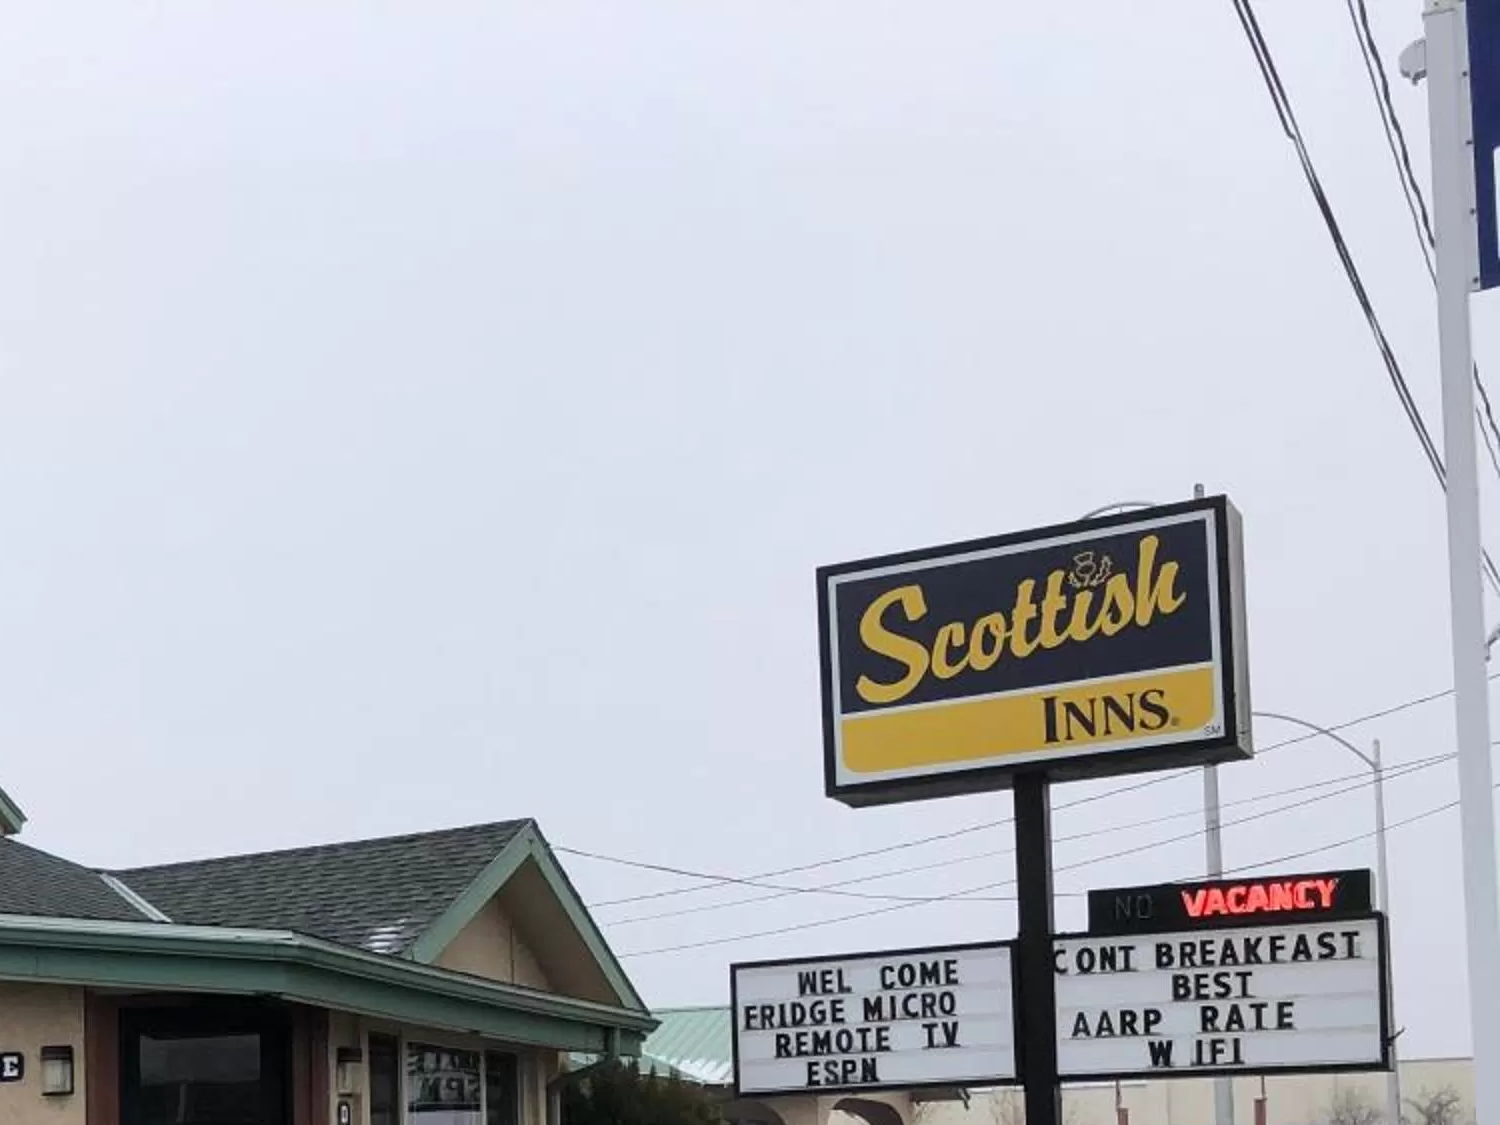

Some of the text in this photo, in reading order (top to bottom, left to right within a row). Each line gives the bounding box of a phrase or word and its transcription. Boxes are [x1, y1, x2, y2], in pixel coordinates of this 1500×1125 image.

[855, 535, 1186, 704] Scottish
[1115, 879, 1339, 920] NO VACANCY
[1053, 931, 1361, 975] CONT BREAKFAST
[1171, 970, 1253, 1001] BEST
[744, 991, 957, 1030] FRIDGE MICRO
[1071, 1001, 1295, 1038] AARP RATE
[775, 1021, 961, 1058] REMOTE TV
[806, 1057, 880, 1087] ESPN
